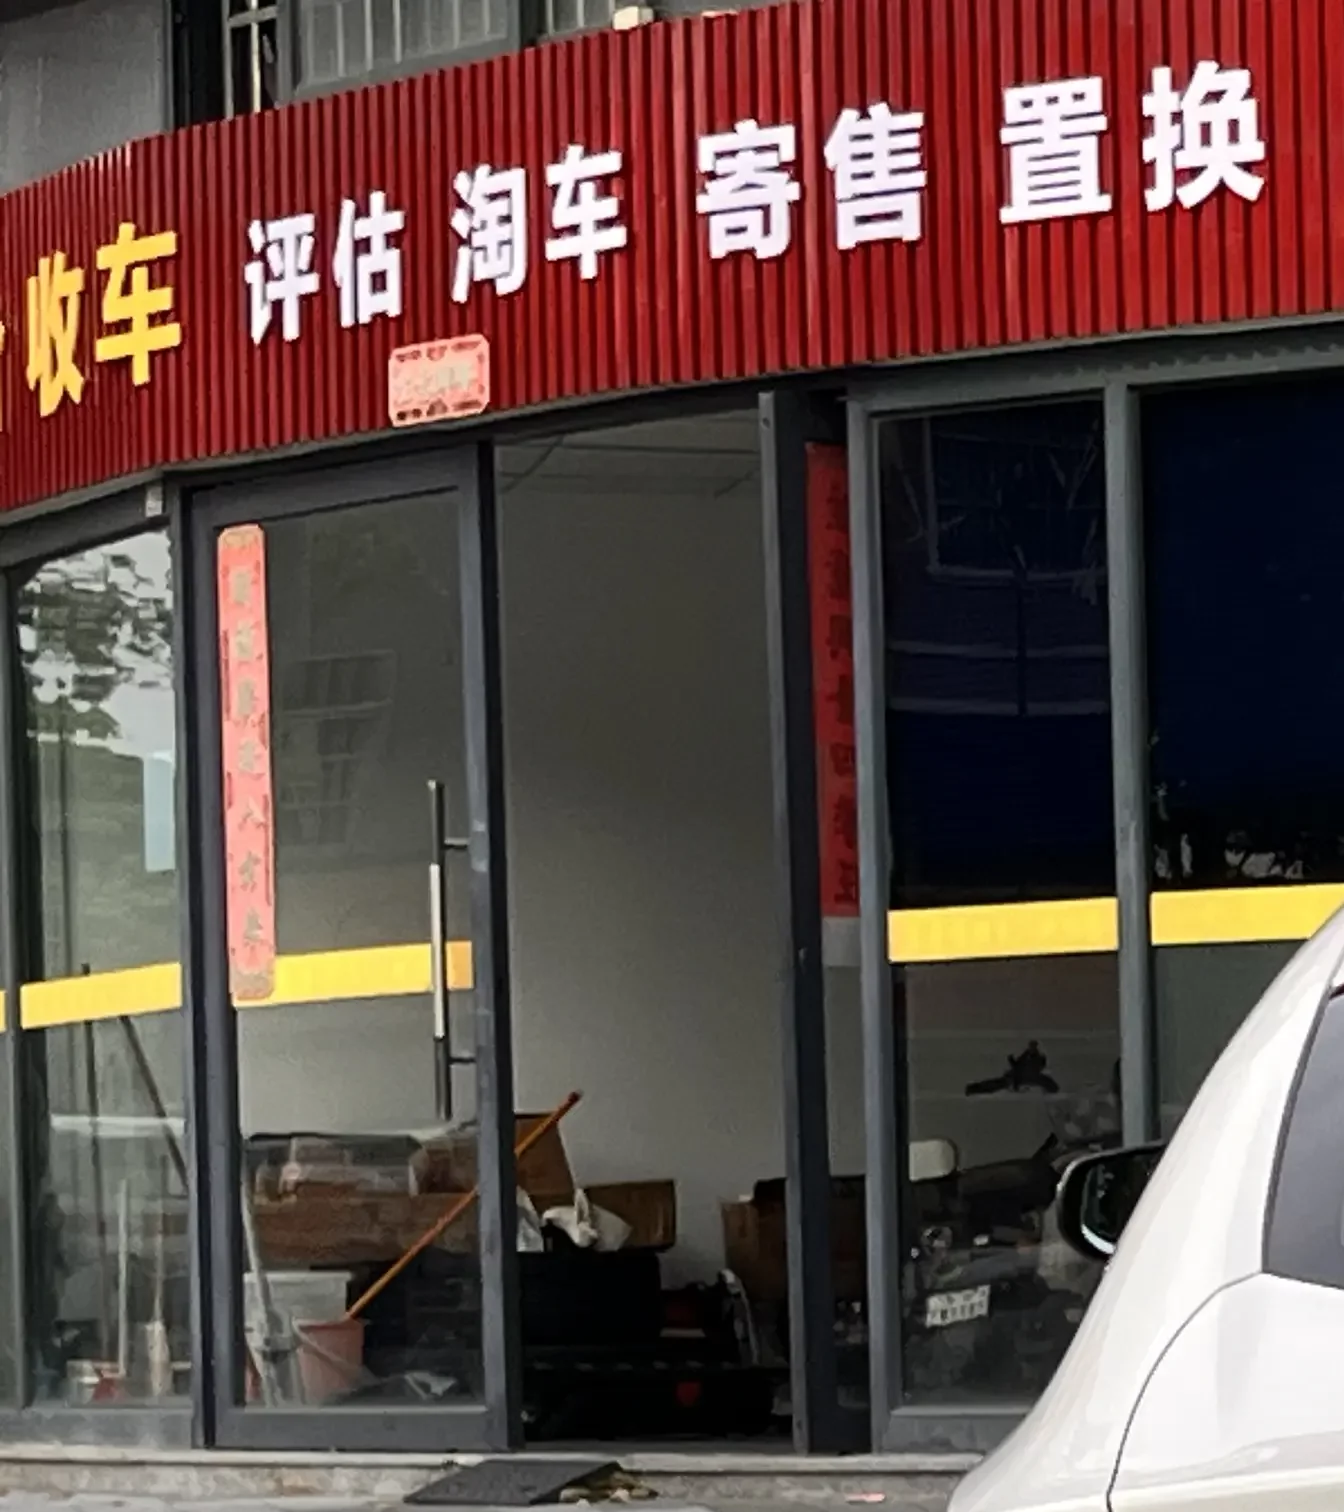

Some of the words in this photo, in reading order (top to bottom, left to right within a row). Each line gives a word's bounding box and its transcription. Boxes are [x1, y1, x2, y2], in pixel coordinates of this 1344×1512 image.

[0, 221, 181, 417] 收车
[245, 192, 406, 345] 评估
[450, 144, 627, 304] 淘车
[697, 103, 927, 261] 寄售
[1000, 60, 1266, 225] 置换
